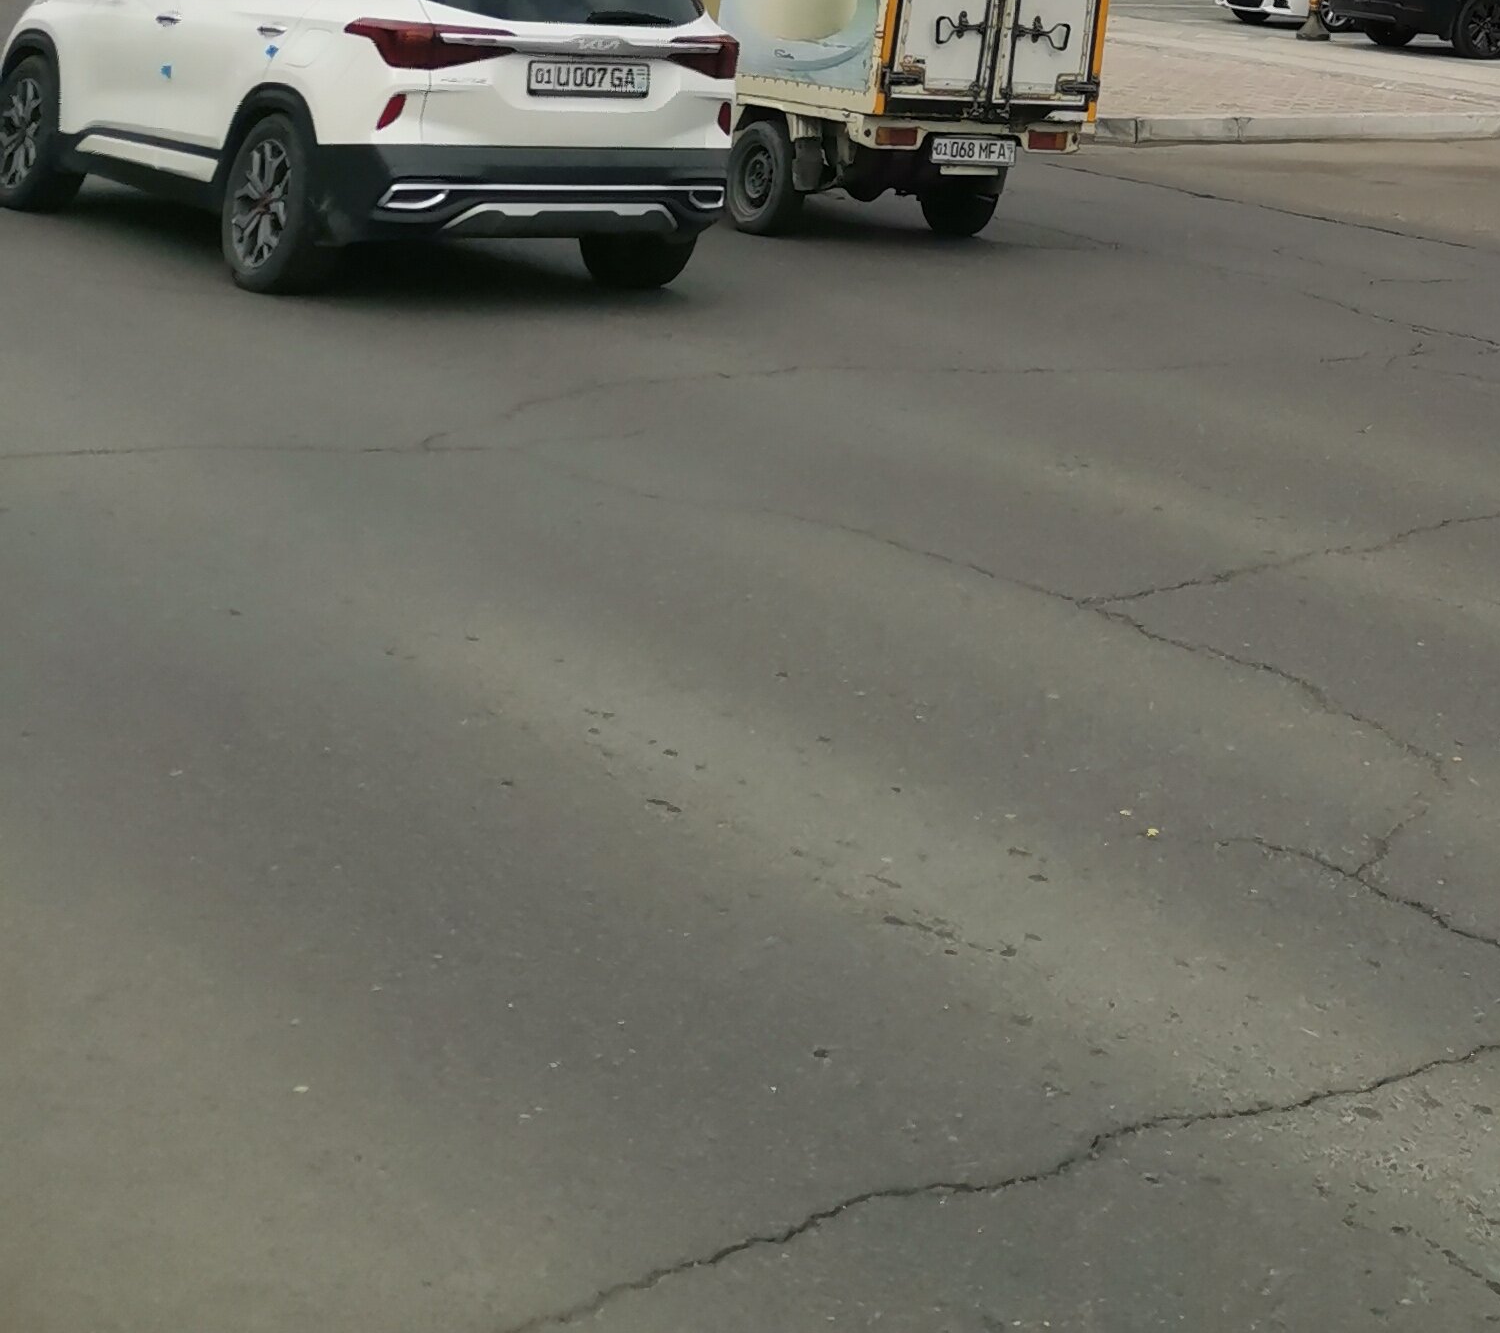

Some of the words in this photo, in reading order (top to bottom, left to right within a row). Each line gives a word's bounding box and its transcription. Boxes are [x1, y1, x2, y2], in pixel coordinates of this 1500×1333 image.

[535, 68, 552, 84] 01
[935, 142, 948, 155] 01
[950, 141, 975, 159] 068
[978, 142, 1006, 159] MFA
